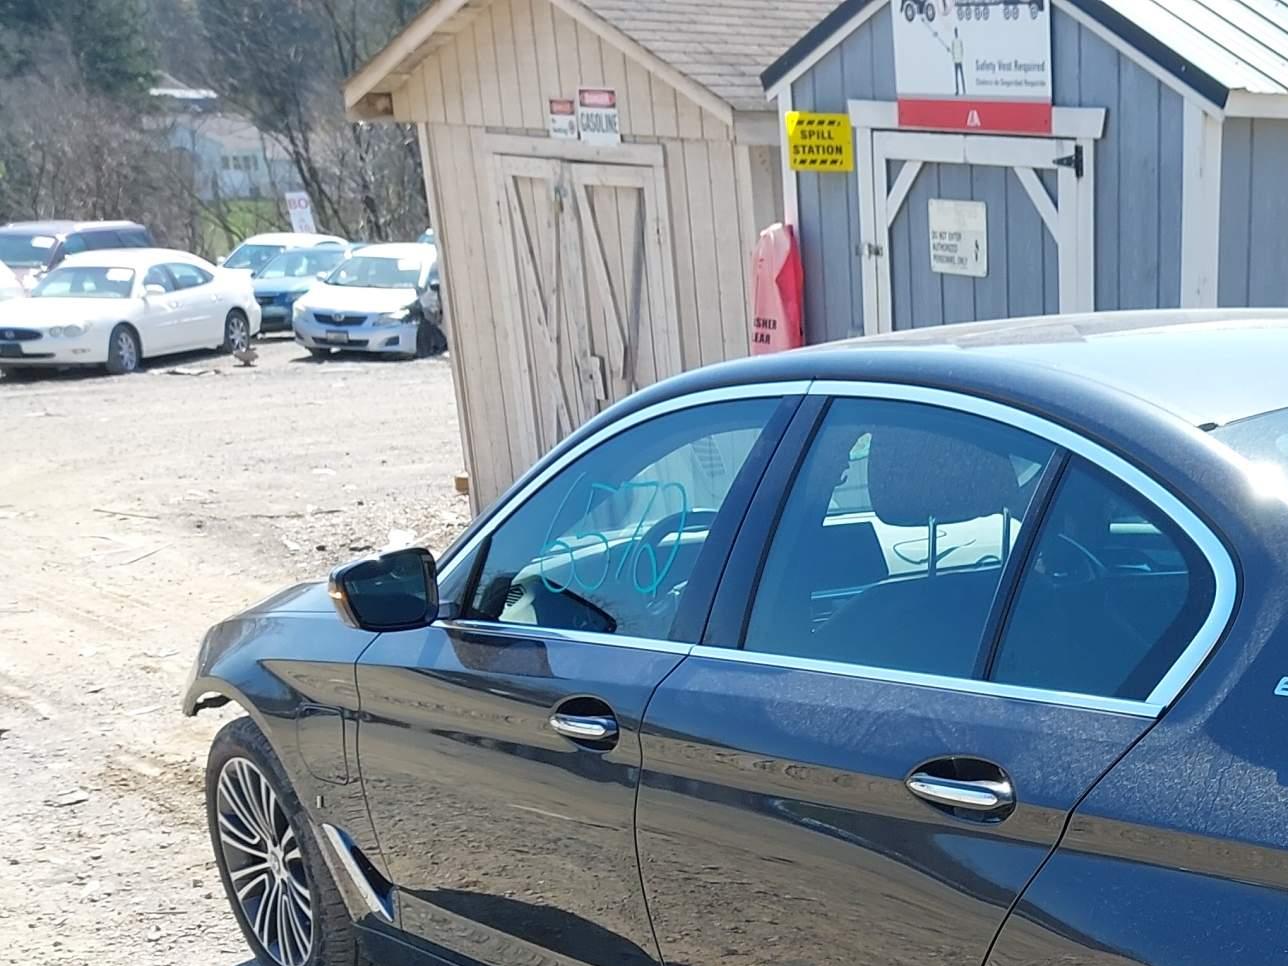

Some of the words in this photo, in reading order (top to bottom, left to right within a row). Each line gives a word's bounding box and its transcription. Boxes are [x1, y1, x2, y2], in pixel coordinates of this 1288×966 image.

[975, 59, 996, 74] Safety
[998, 60, 1012, 72] Vest
[1014, 59, 1046, 74] Required
[580, 112, 618, 133] GASOLINE
[800, 129, 834, 141] SPILL
[793, 144, 843, 156] STATION
